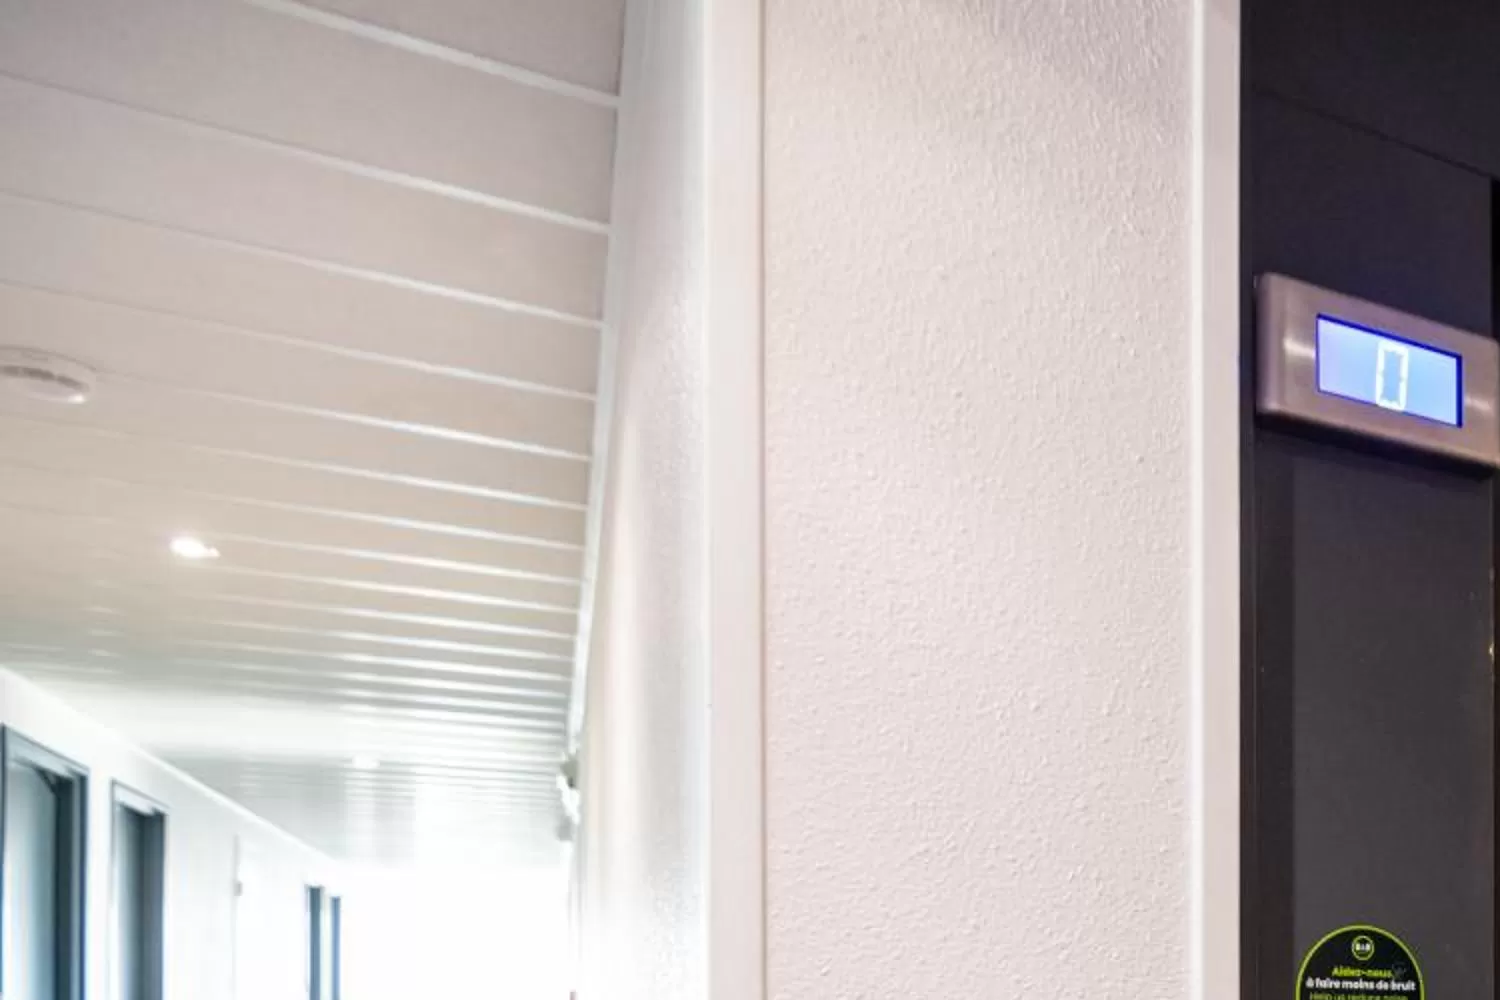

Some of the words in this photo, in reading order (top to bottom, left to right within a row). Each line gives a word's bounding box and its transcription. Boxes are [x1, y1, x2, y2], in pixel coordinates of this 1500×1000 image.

[1375, 340, 1409, 411] 0
[1332, 966, 1393, 978] Aidez-nous
[1315, 978, 1341, 989] faire
[1342, 979, 1375, 990] moins
[1376, 980, 1390, 990] de
[1391, 980, 1417, 991] bruit
